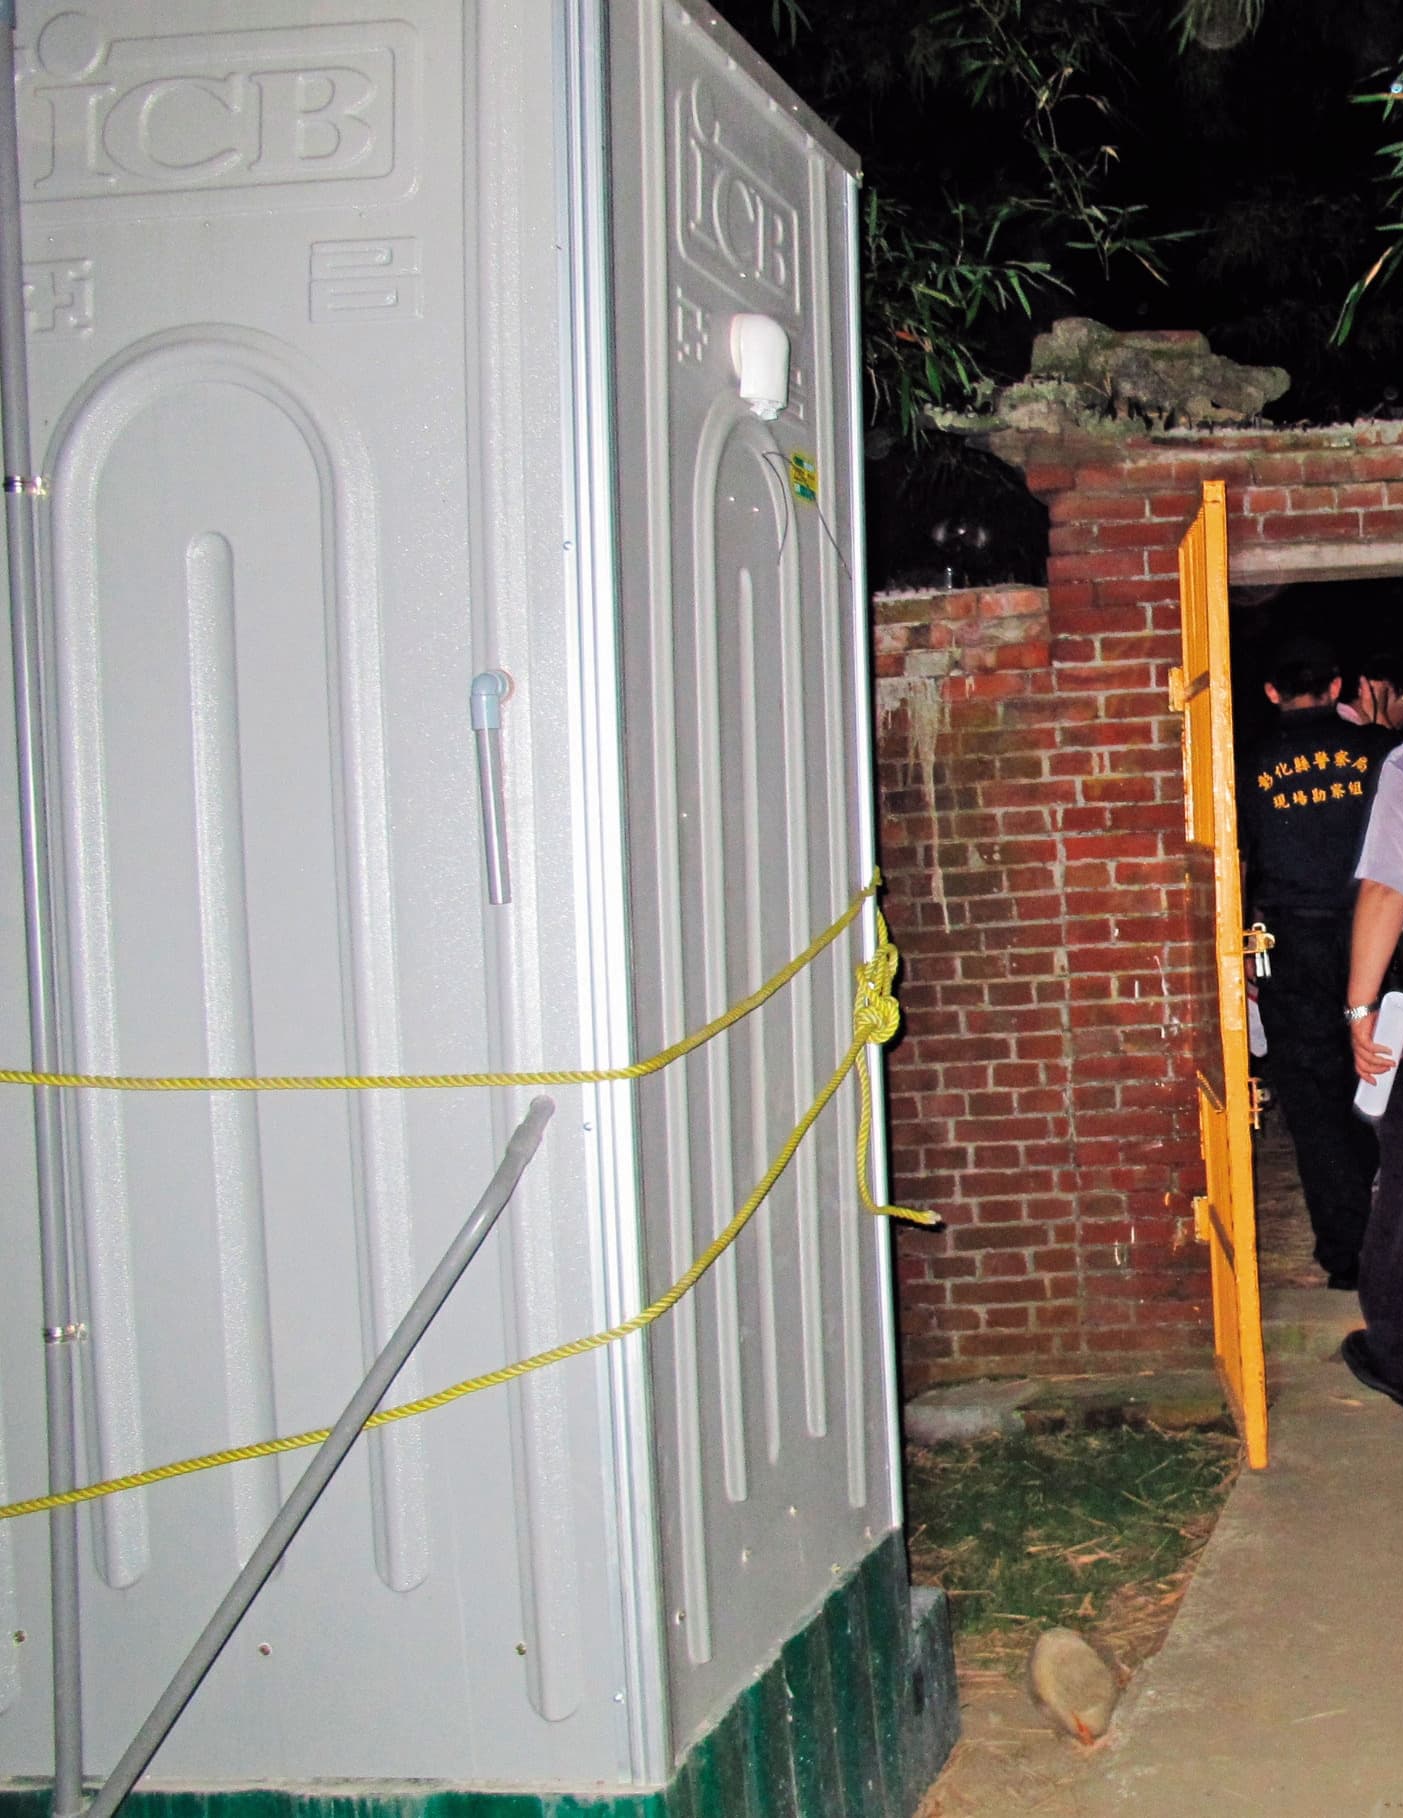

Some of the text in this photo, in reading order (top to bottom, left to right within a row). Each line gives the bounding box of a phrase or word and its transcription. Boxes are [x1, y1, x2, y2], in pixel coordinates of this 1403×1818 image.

[1257, 750, 1369, 791] 彰化縣警察局
[1273, 781, 1364, 809] 現場勘察組
